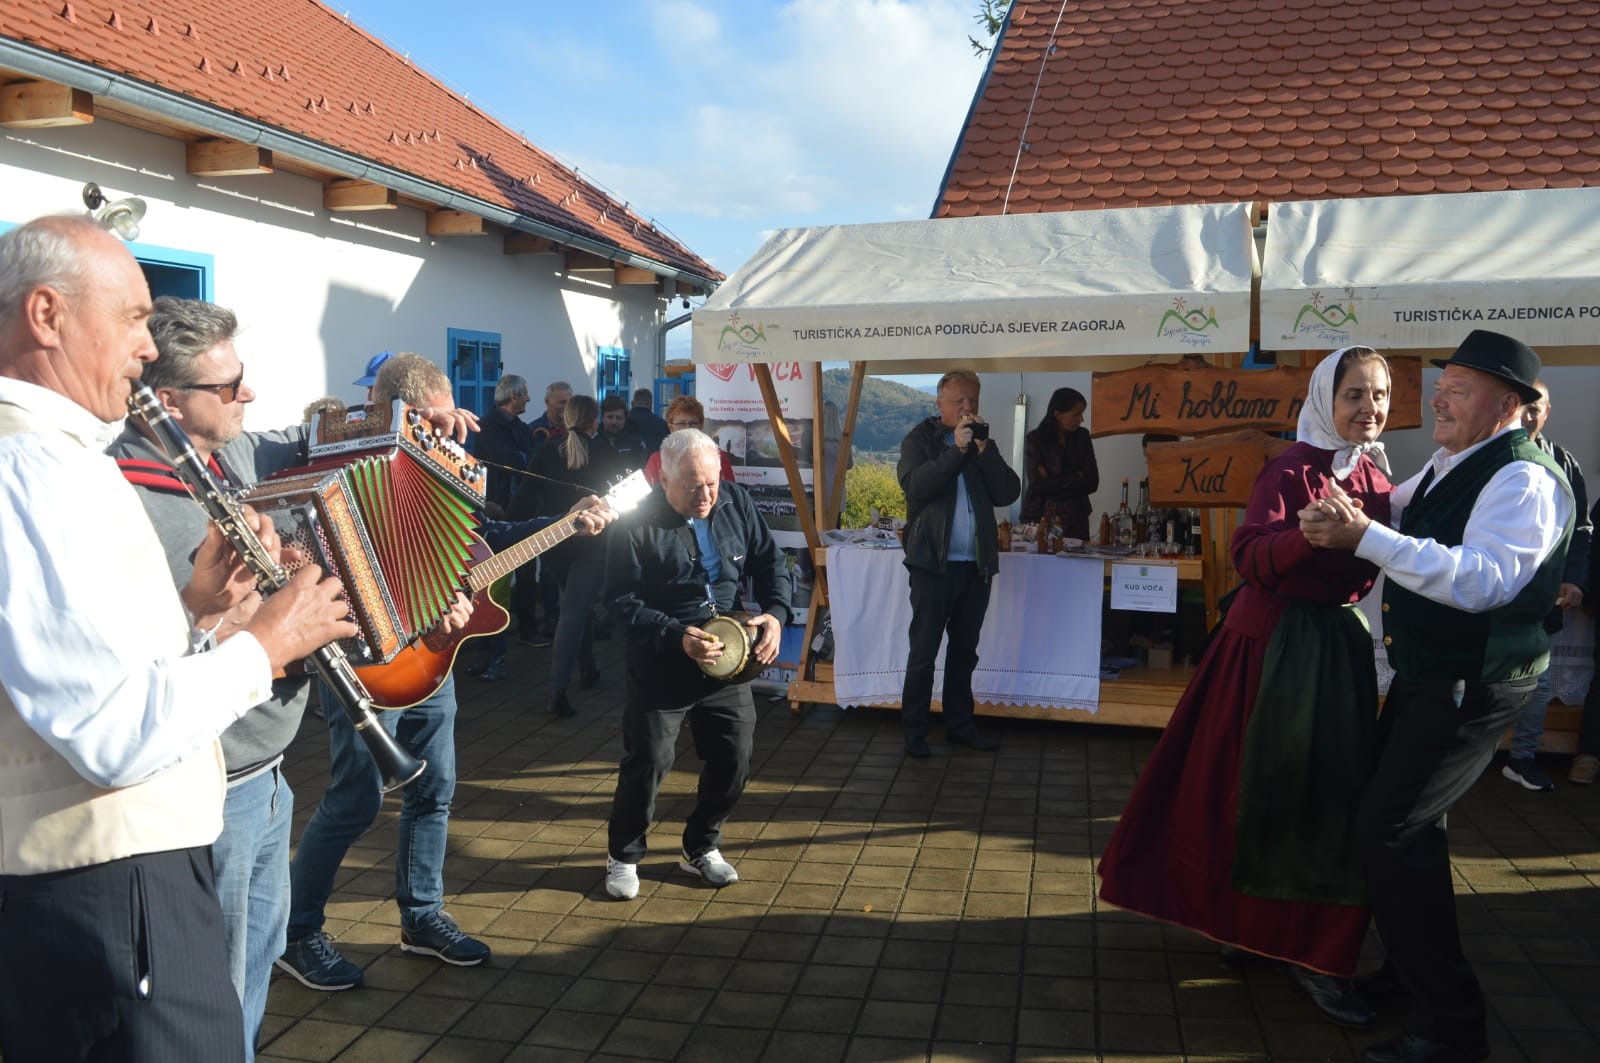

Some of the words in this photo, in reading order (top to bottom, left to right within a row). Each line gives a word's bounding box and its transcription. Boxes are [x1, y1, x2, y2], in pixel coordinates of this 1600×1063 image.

[1394, 307, 1484, 323] TURISTIČKA
[1487, 307, 1575, 321] ZAJEDNICA
[793, 326, 862, 340] TURISTIČKA
[864, 325, 932, 338] ZAJEDNICA
[935, 321, 1005, 335] PODRUČJA
[1007, 321, 1057, 333] SJEVER
[1061, 319, 1125, 332] ZAGORJA
[1120, 381, 1161, 421] Mi
[1173, 456, 1233, 494] Kud
[1124, 583, 1140, 591] KUD
